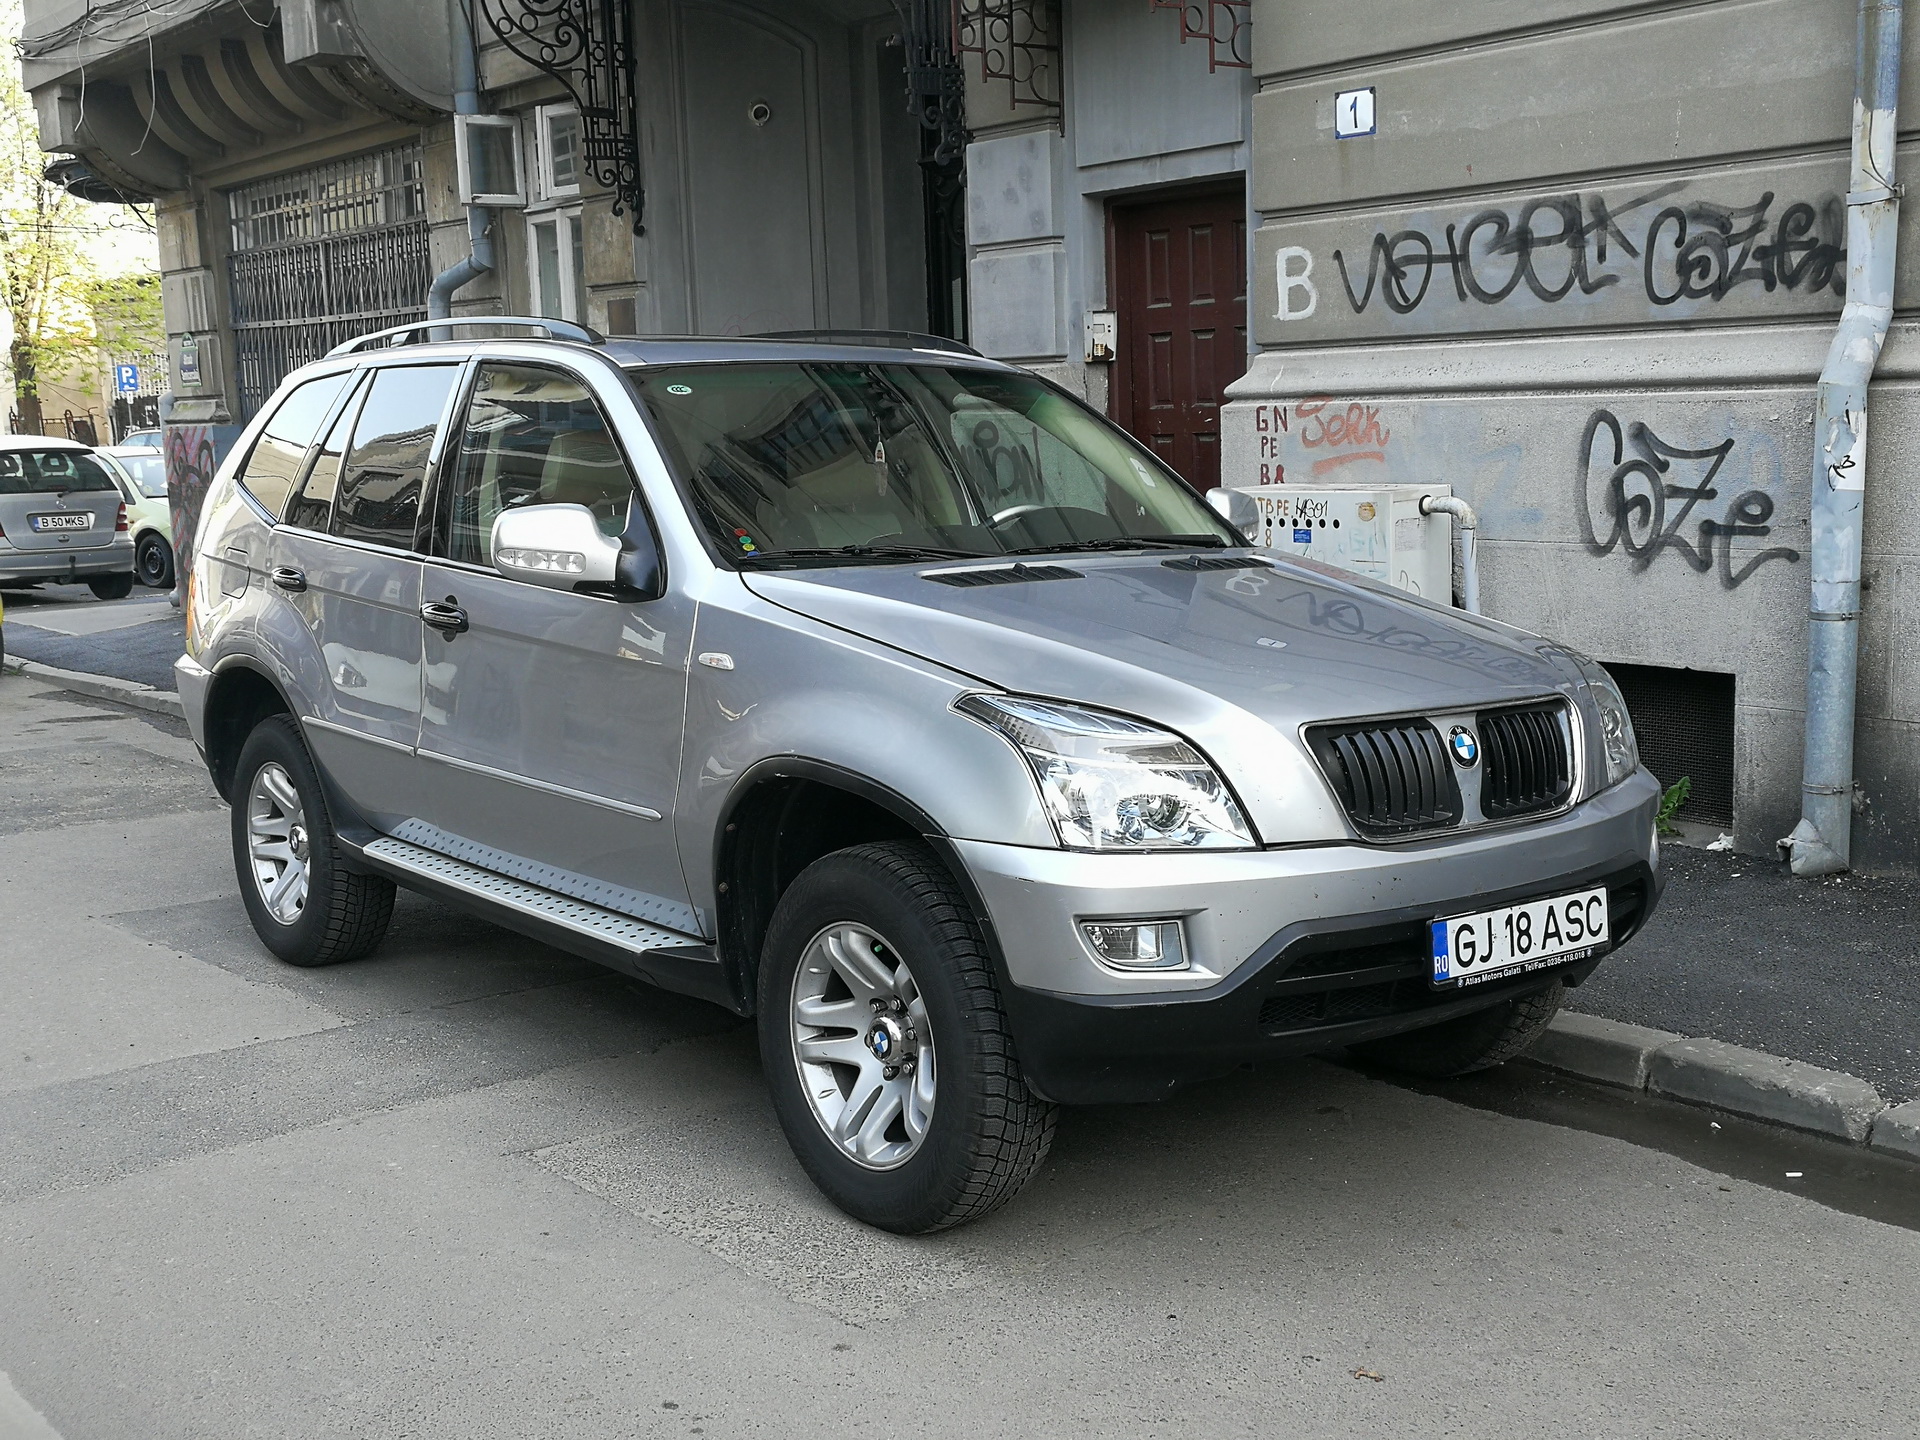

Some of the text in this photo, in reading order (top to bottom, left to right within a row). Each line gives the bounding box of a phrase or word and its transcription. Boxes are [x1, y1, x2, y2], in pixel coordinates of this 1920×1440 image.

[1349, 96, 1358, 128] 1
[1272, 246, 1319, 321] B
[121, 367, 133, 383] P
[1261, 435, 1278, 459] PE
[42, 518, 49, 527] B
[52, 517, 63, 526] 50
[65, 517, 84, 526] MKS
[1454, 895, 1603, 968] GJ 18 ASC
[1434, 955, 1449, 974] RO
[1465, 973, 1481, 986] Atlas
[1482, 970, 1502, 982] Motors
